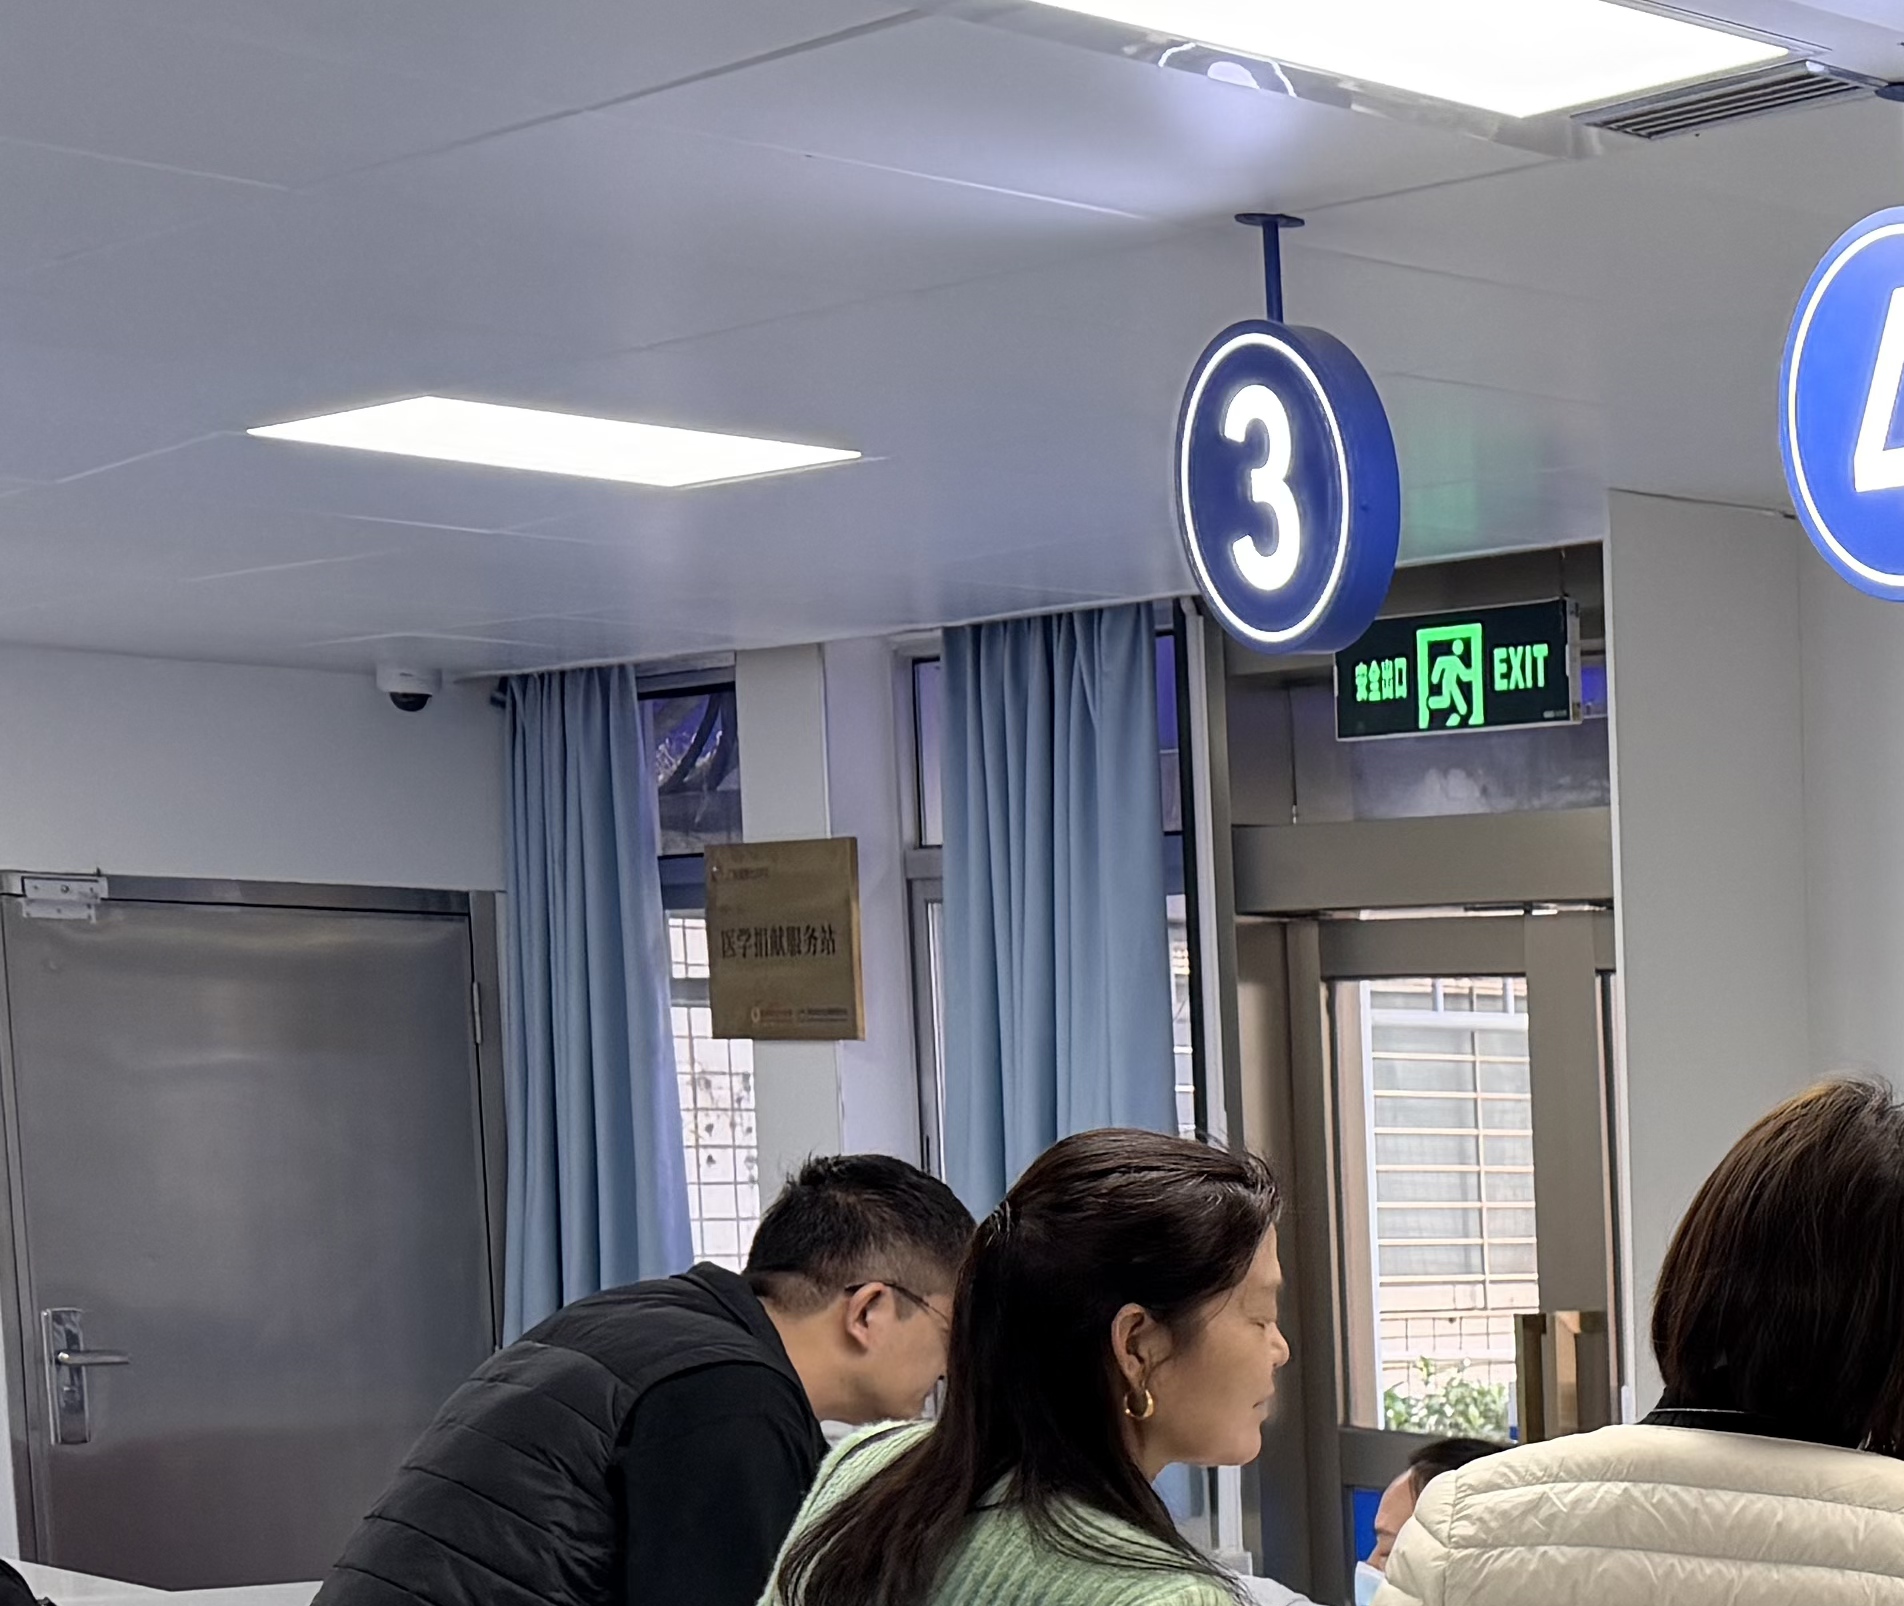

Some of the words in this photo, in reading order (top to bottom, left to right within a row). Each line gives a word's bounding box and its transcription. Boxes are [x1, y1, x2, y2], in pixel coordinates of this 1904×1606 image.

[1222, 383, 1302, 592] 3
[1354, 657, 1407, 702] 安全出口
[1493, 643, 1549, 692] EXIT
